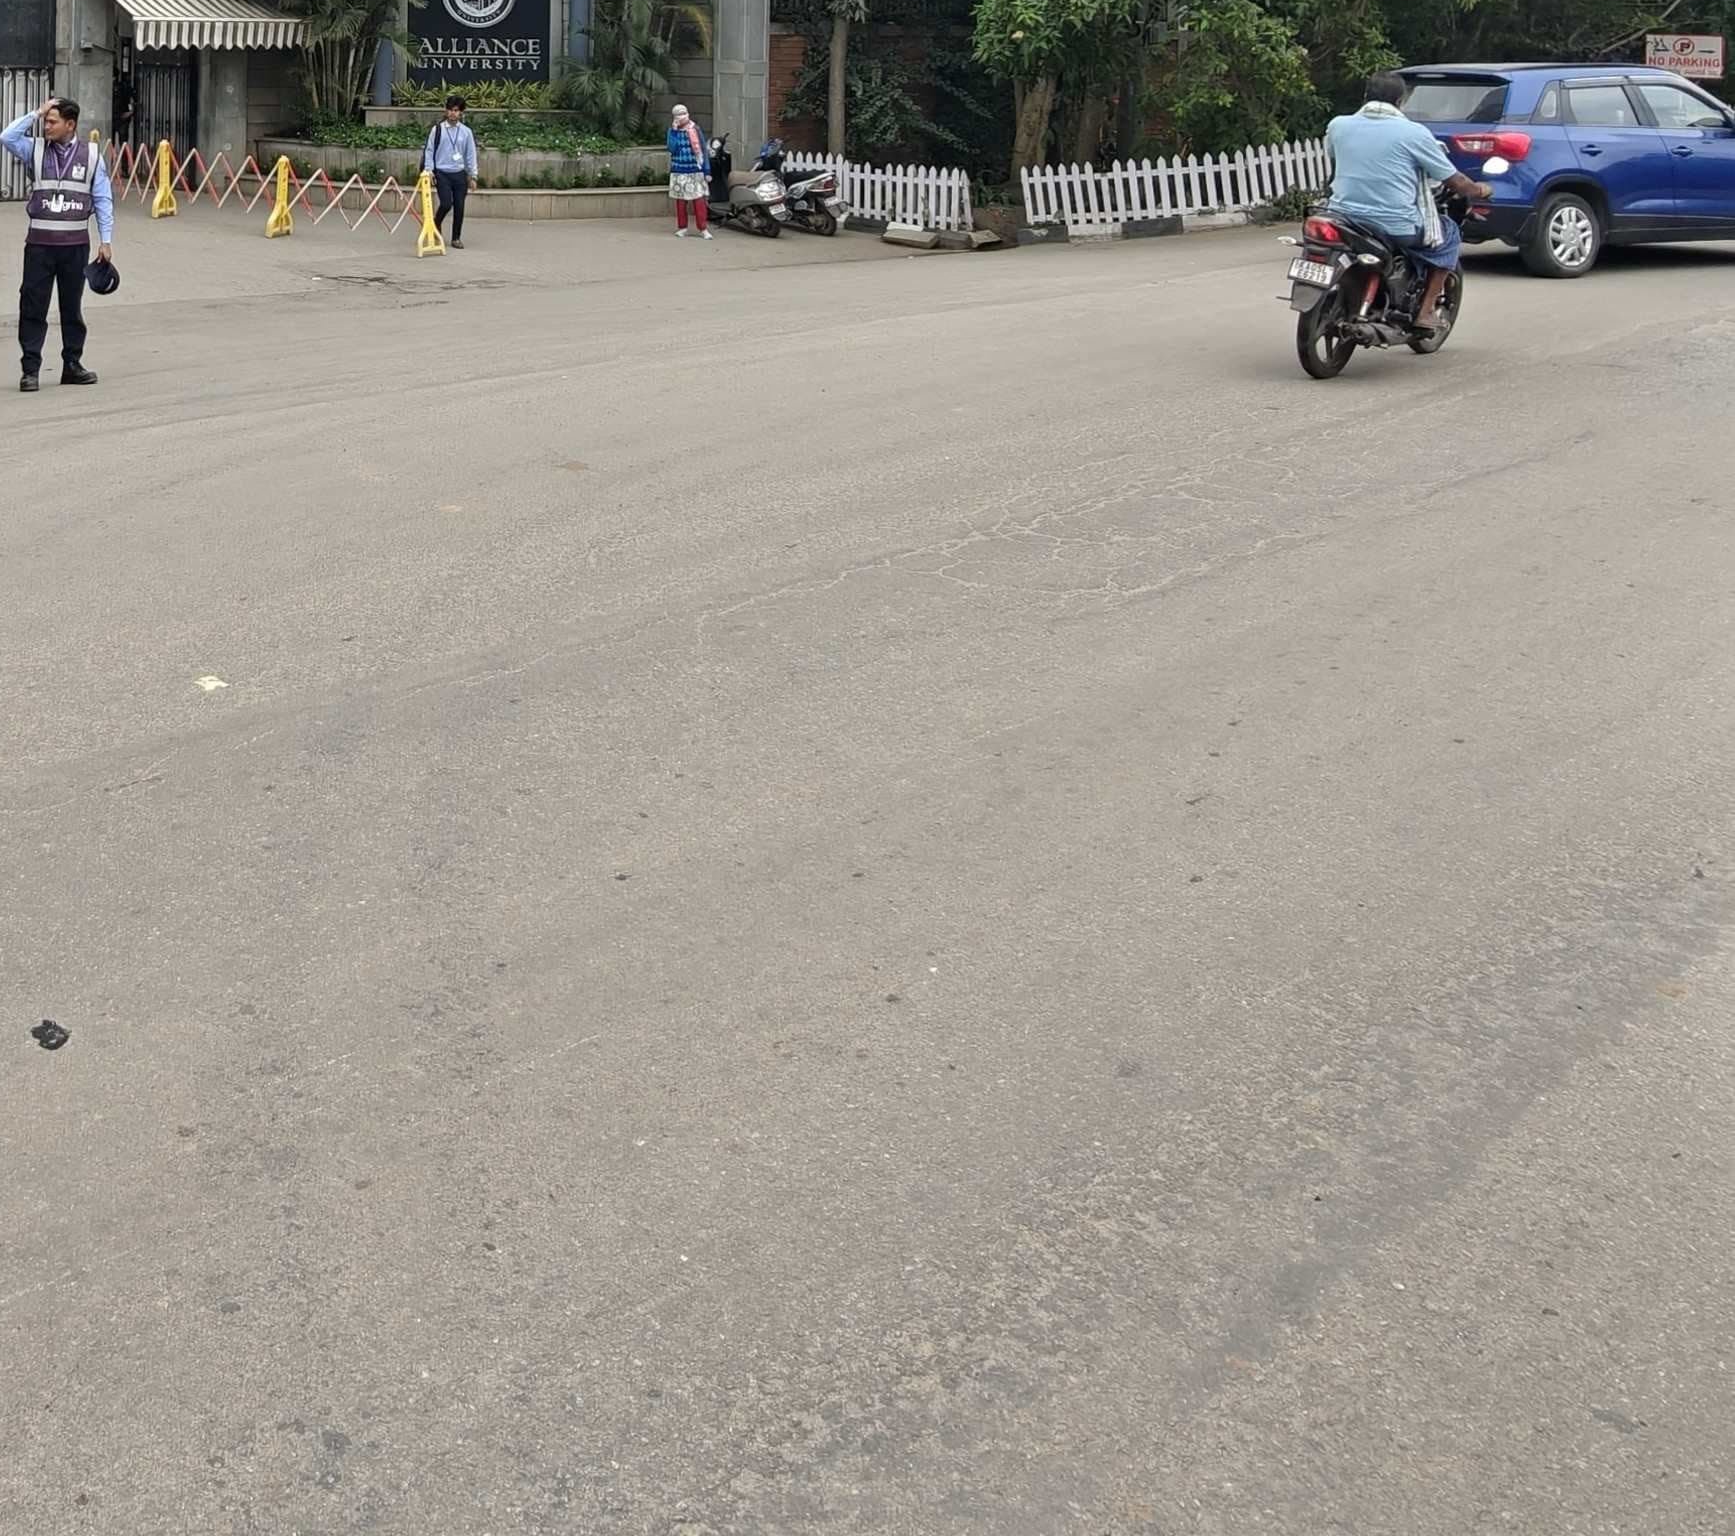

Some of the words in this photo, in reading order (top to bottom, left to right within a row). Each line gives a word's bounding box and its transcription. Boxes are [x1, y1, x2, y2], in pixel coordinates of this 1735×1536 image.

[418, 37, 541, 55] ALLIANCE
[417, 57, 541, 70] UNIVERSITY
[1648, 55, 1665, 66] NO
[1668, 56, 1721, 68] PARKING
